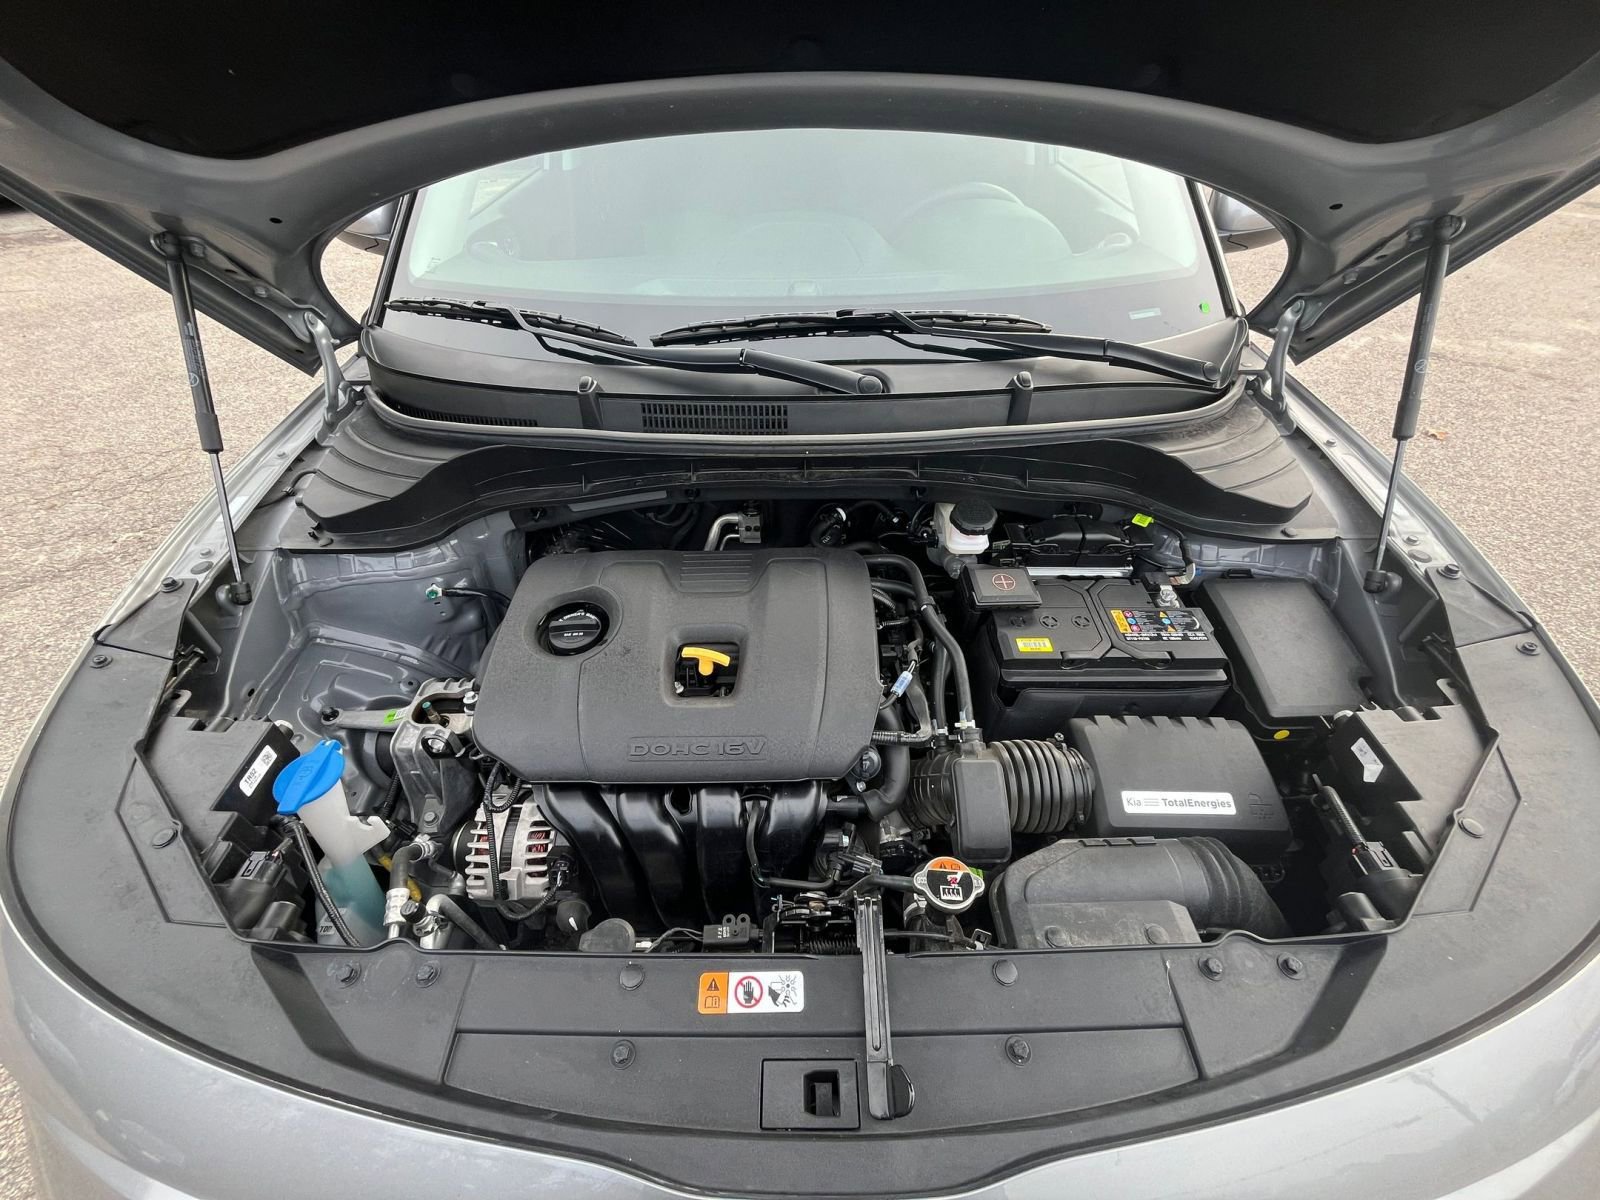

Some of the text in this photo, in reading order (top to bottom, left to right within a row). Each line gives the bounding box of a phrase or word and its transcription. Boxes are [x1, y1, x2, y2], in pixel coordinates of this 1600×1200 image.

[629, 740, 766, 757] DOHC 16V
[1126, 797, 1232, 809] Kia TotalEnergies
